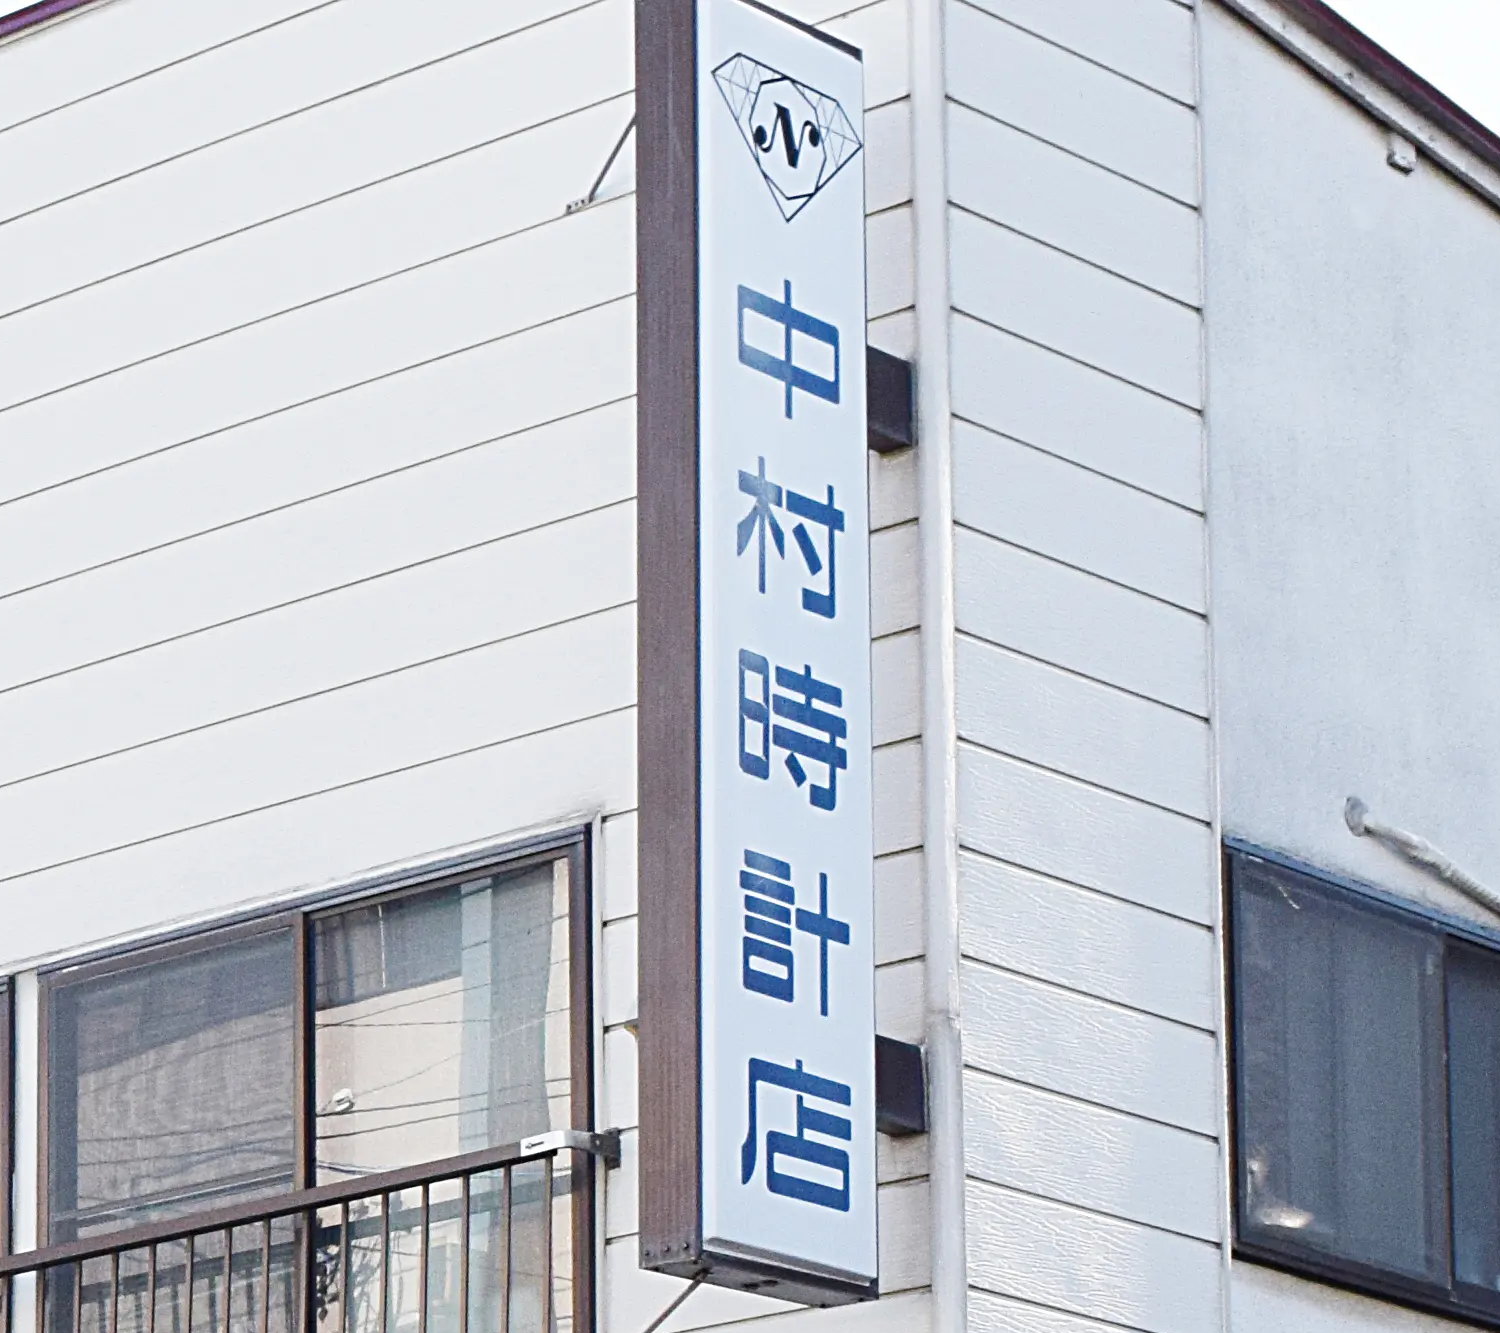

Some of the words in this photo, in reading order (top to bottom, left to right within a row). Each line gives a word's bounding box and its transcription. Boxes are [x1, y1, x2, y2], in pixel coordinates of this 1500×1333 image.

[736, 279, 851, 1214] 中村時計店
